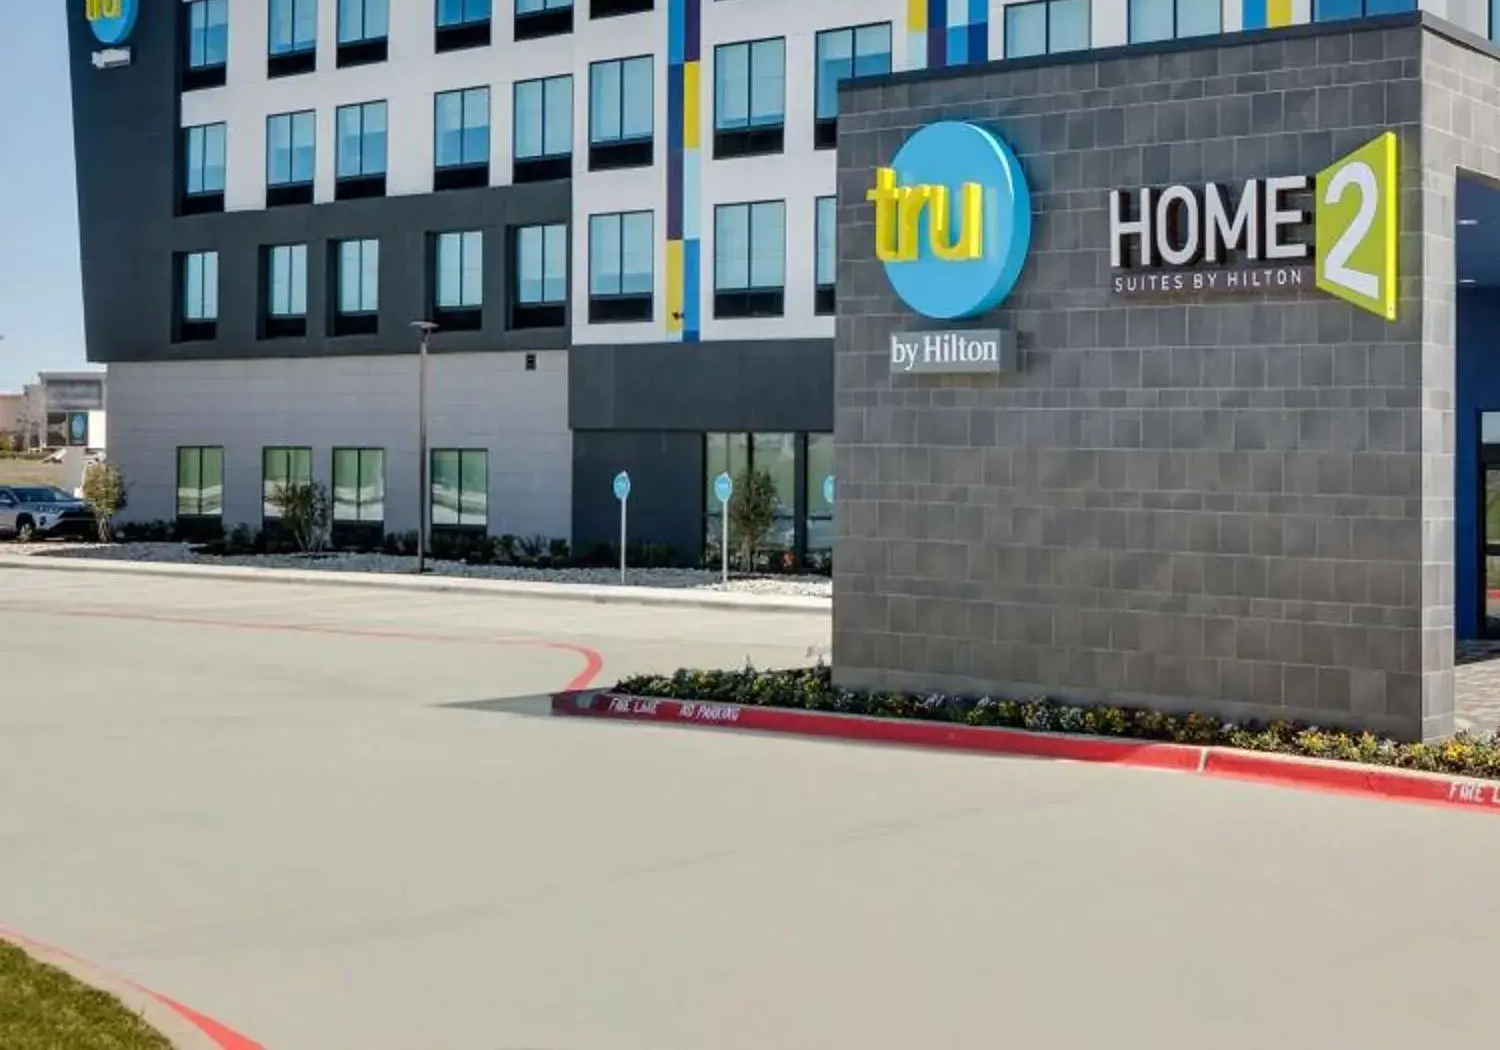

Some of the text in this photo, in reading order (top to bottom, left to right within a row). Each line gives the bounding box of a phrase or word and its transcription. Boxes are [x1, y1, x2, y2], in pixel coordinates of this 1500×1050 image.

[866, 167, 982, 263] tru
[1109, 175, 1307, 267] HOME
[1115, 269, 1302, 293] SUITES BY HILTON
[890, 333, 998, 371] by Hilton
[1448, 781, 1485, 803] FIRE
